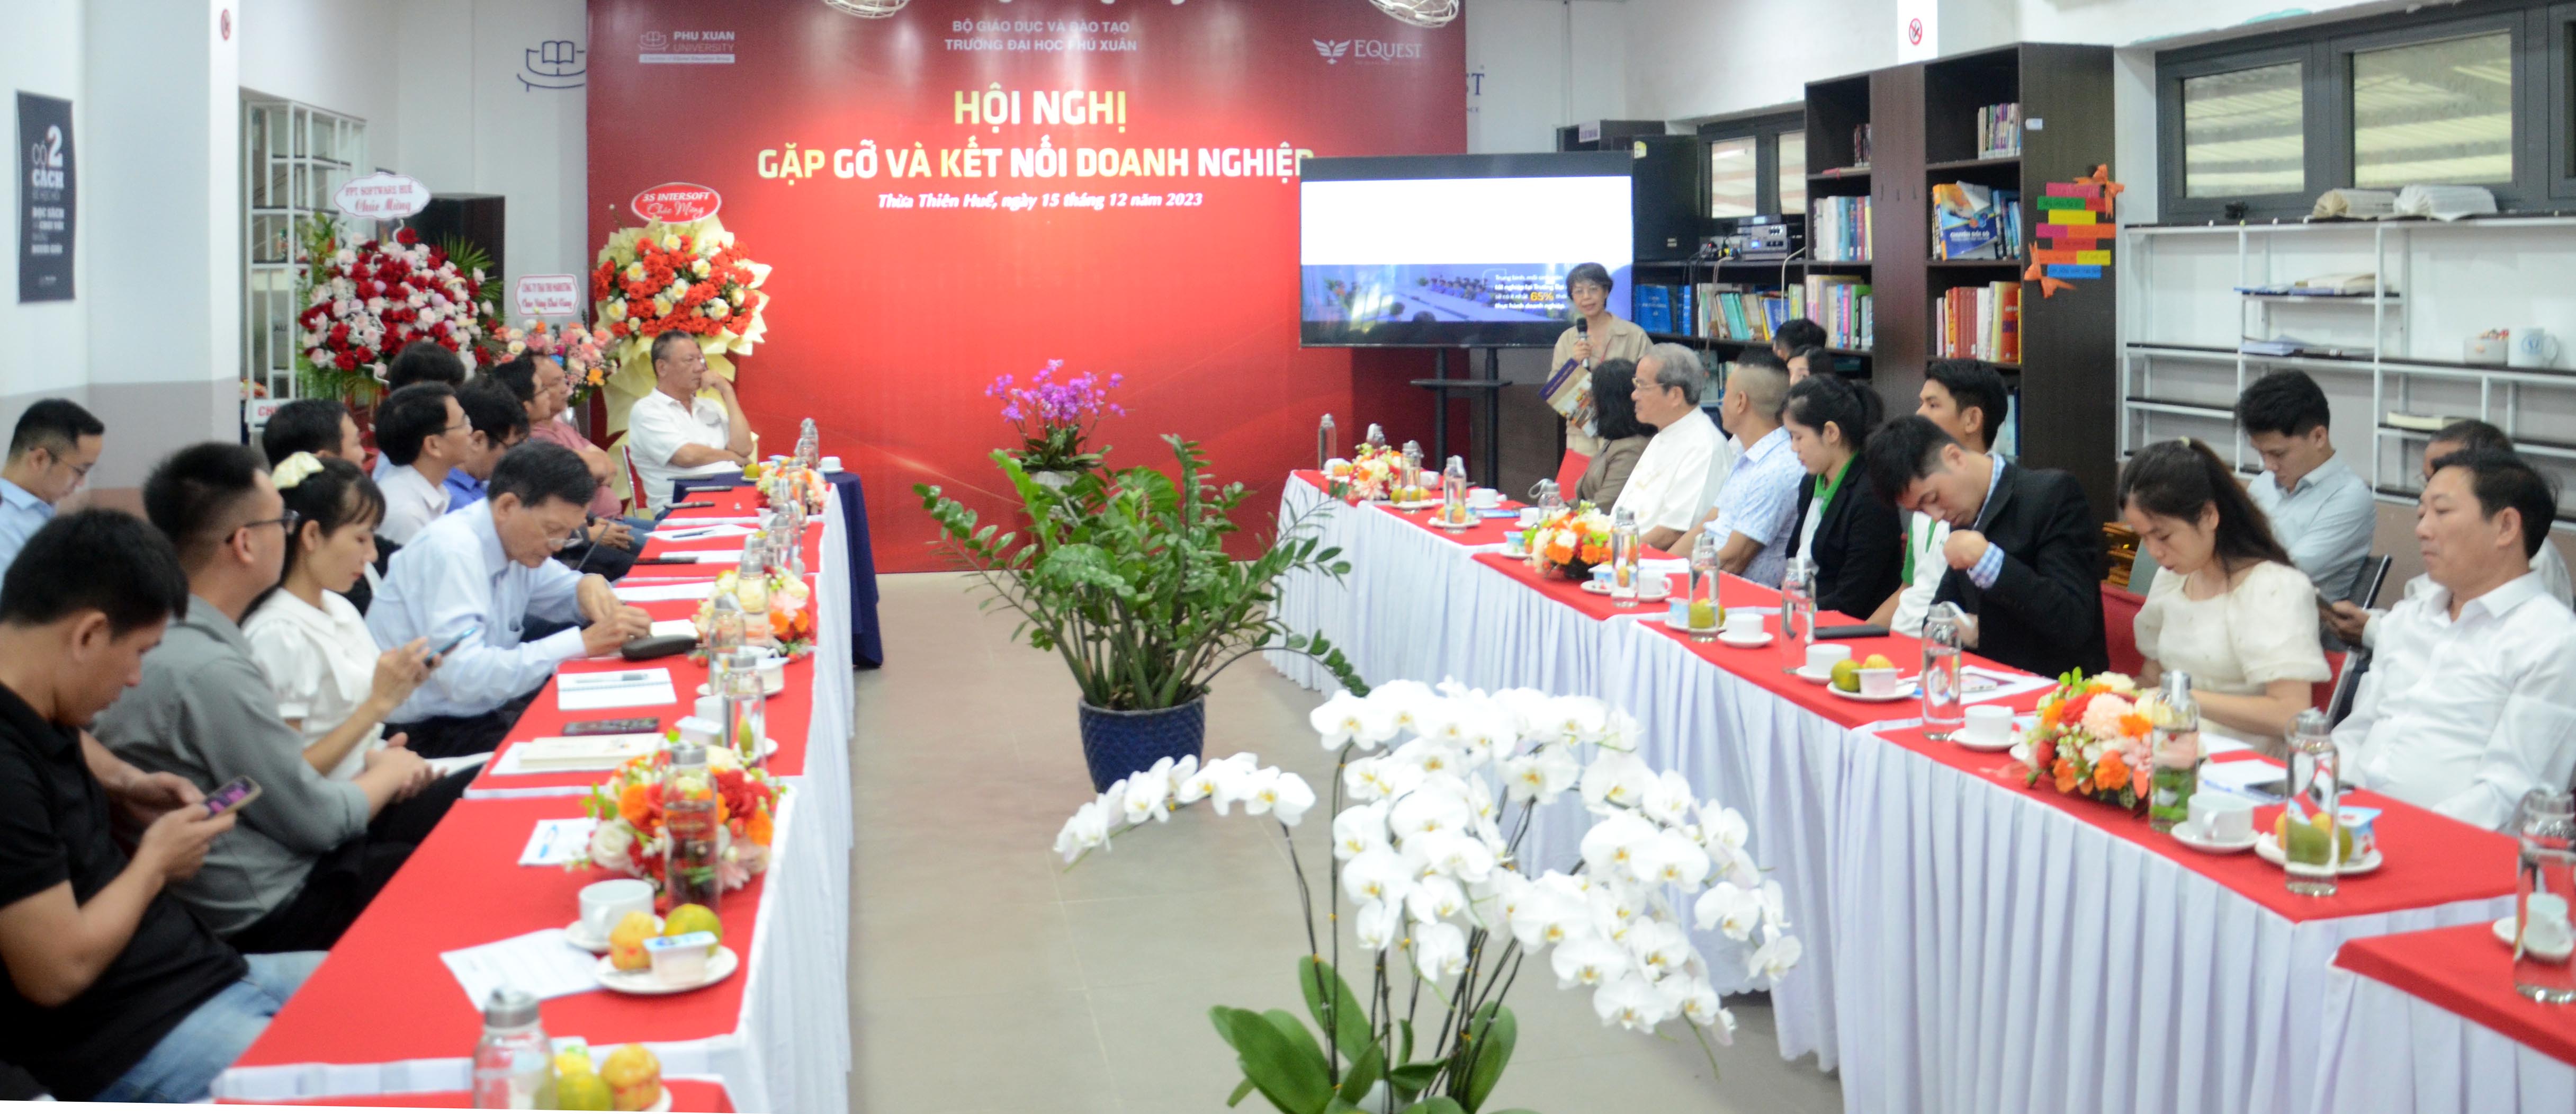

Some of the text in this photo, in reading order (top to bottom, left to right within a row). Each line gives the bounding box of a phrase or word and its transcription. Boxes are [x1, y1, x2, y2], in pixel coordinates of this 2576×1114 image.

[952, 18, 973, 34] BỘ
[976, 19, 1011, 32] GIÁO
[1014, 21, 1043, 34] DỤC
[1047, 19, 1066, 32] VÀ
[1102, 21, 1130, 34] TẠO
[674, 31, 735, 40] PHU XUAN
[673, 43, 734, 52] UNIVERSITY
[944, 37, 1137, 52] TRƯỜNG ĐẠI HỌC PHÚ XUÂN
[954, 82, 1127, 134] HỘI NGHỊ
[47, 124, 63, 167] 2
[757, 142, 825, 186] GẶP
[833, 139, 878, 179] GỠ
[885, 141, 932, 178] VÀ
[940, 135, 1003, 178] KẾT
[1010, 135, 1067, 177] NỐI
[1076, 148, 1189, 177] DOANH
[642, 192, 711, 202] 3S INTERSOFT
[878, 190, 1203, 211] Thừa Thiên Huế, ngày 15 tháng 12 năm 2023
[1530, 291, 1554, 301] 65%
